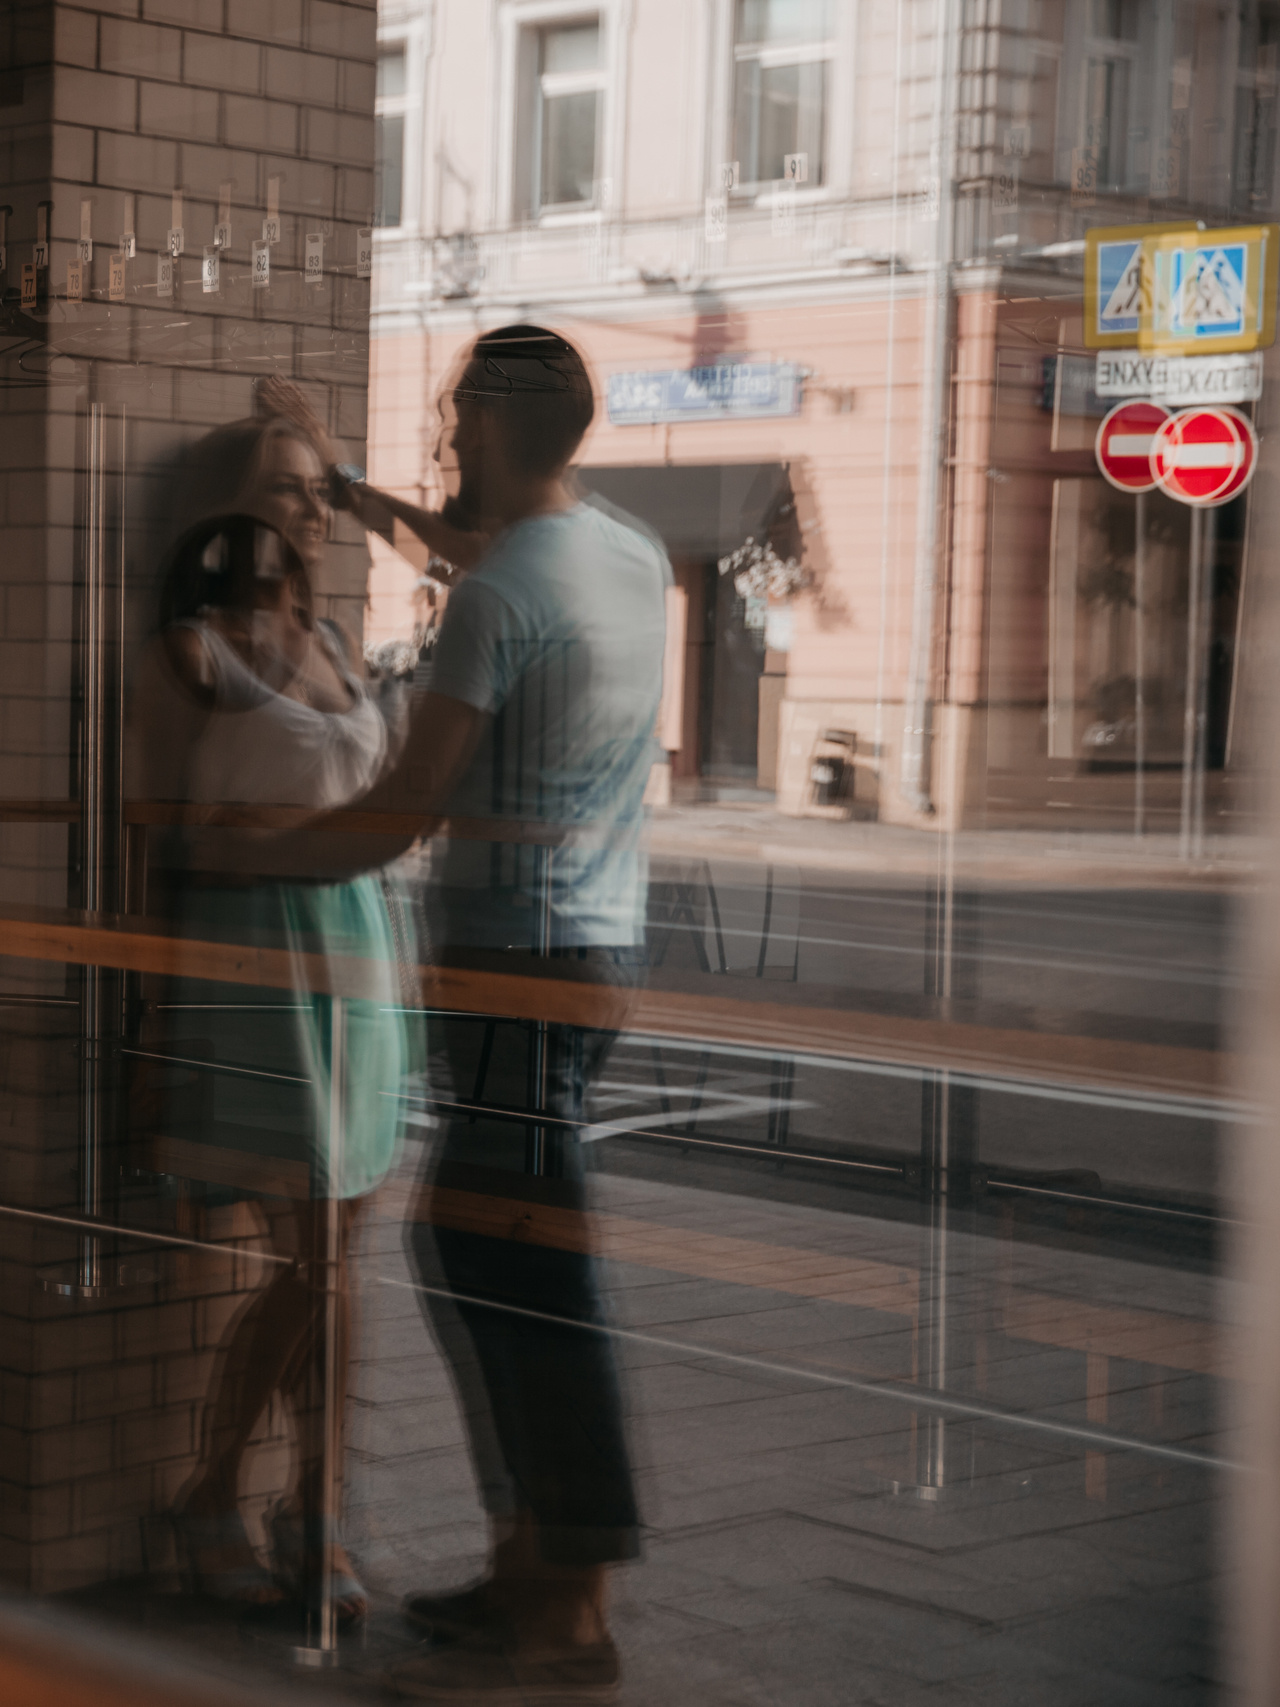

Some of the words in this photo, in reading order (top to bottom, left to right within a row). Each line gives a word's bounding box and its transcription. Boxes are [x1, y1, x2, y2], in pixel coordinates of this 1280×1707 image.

[790, 159, 803, 181] 91
[1157, 156, 1175, 179] 96
[999, 173, 1015, 195] 94
[1076, 165, 1092, 189] 95
[711, 205, 725, 225] 90
[218, 228, 227, 247] 81
[266, 223, 277, 241] 82
[171, 233, 181, 251] 80
[35, 248, 45, 265] 77
[80, 243, 89, 261] 78
[361, 250, 372, 263] 84
[207, 259, 217, 277] 81
[256, 255, 267, 272] 82
[308, 255, 320, 268] 83
[70, 274, 80, 290] 78
[113, 270, 122, 286] 79
[161, 265, 171, 282] 80
[24, 278, 34, 294] 77
